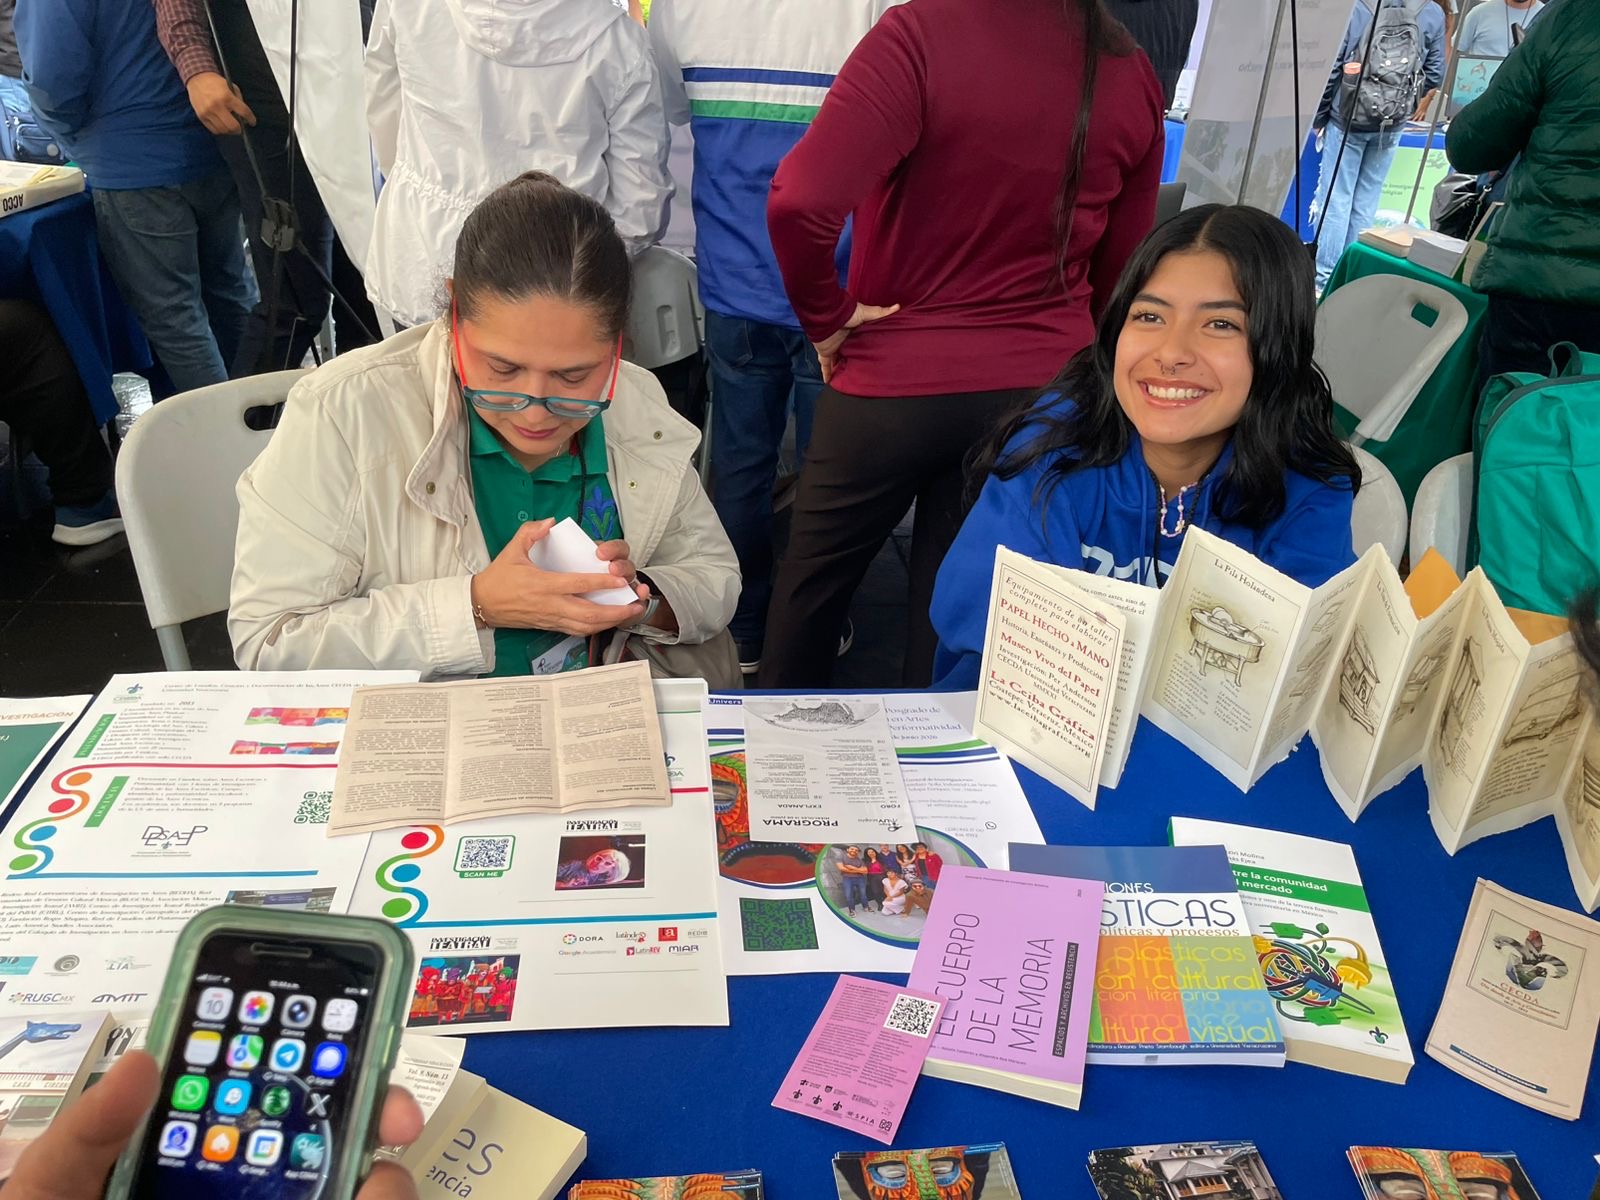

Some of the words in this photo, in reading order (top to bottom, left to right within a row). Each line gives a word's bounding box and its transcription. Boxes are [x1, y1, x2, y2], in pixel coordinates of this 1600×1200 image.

[2, 193, 24, 212] ACCO
[1214, 558, 1224, 570] La
[1005, 576, 1063, 612] Equipamiento
[1065, 608, 1075, 620] de
[1090, 622, 1114, 642] taller
[1009, 589, 1048, 614] completo
[1050, 610, 1070, 625] para
[1071, 622, 1107, 648] elaborar
[1000, 598, 1031, 622] PAPEL
[1032, 614, 1070, 644] HECHO
[1076, 640, 1110, 669] MANO
[999, 644, 1047, 677] Investigación:
[1049, 672, 1061, 685] Per
[1062, 683, 1097, 709] Anderson
[1000, 632, 1032, 654] Museo
[1034, 649, 1056, 670] Vivo
[1058, 664, 1072, 680] del
[1074, 675, 1101, 698] Papel
[1062, 652, 1067, 660] y
[1068, 652, 1104, 682] Producción
[990, 670, 1006, 685] La
[1010, 680, 1045, 709] Ceiba
[1049, 704, 1095, 741] Gráfica
[1024, 668, 1060, 695] Universidad
[1061, 692, 1096, 718] Veracruzana
[989, 680, 1024, 705] Coatepec
[1064, 726, 1094, 749] México
[1240, 851, 1265, 860] Molina
[1232, 870, 1248, 878] tre
[1250, 872, 1261, 880] la
[1264, 875, 1328, 892] comunidad
[1242, 881, 1293, 894] mercado
[1156, 928, 1167, 937] y
[1170, 928, 1240, 937] procesos
[934, 913, 980, 1001] CUERPO
[1065, 945, 1076, 980] RESISTENCIA
[1114, 939, 1246, 968] plásticas
[975, 976, 1008, 1005] LA
[1064, 981, 1072, 989] EN
[1152, 968, 1262, 990] cultural
[1500, 982, 1539, 1005] CECDA
[206, 1000, 224, 1015] 10
[1008, 938, 1055, 1053] MEMORIA
[1146, 986, 1220, 1002] literaria
[966, 1010, 1001, 1045] DE
[1055, 1026, 1066, 1056] ESPACIOS
[1191, 1016, 1277, 1043] visual
